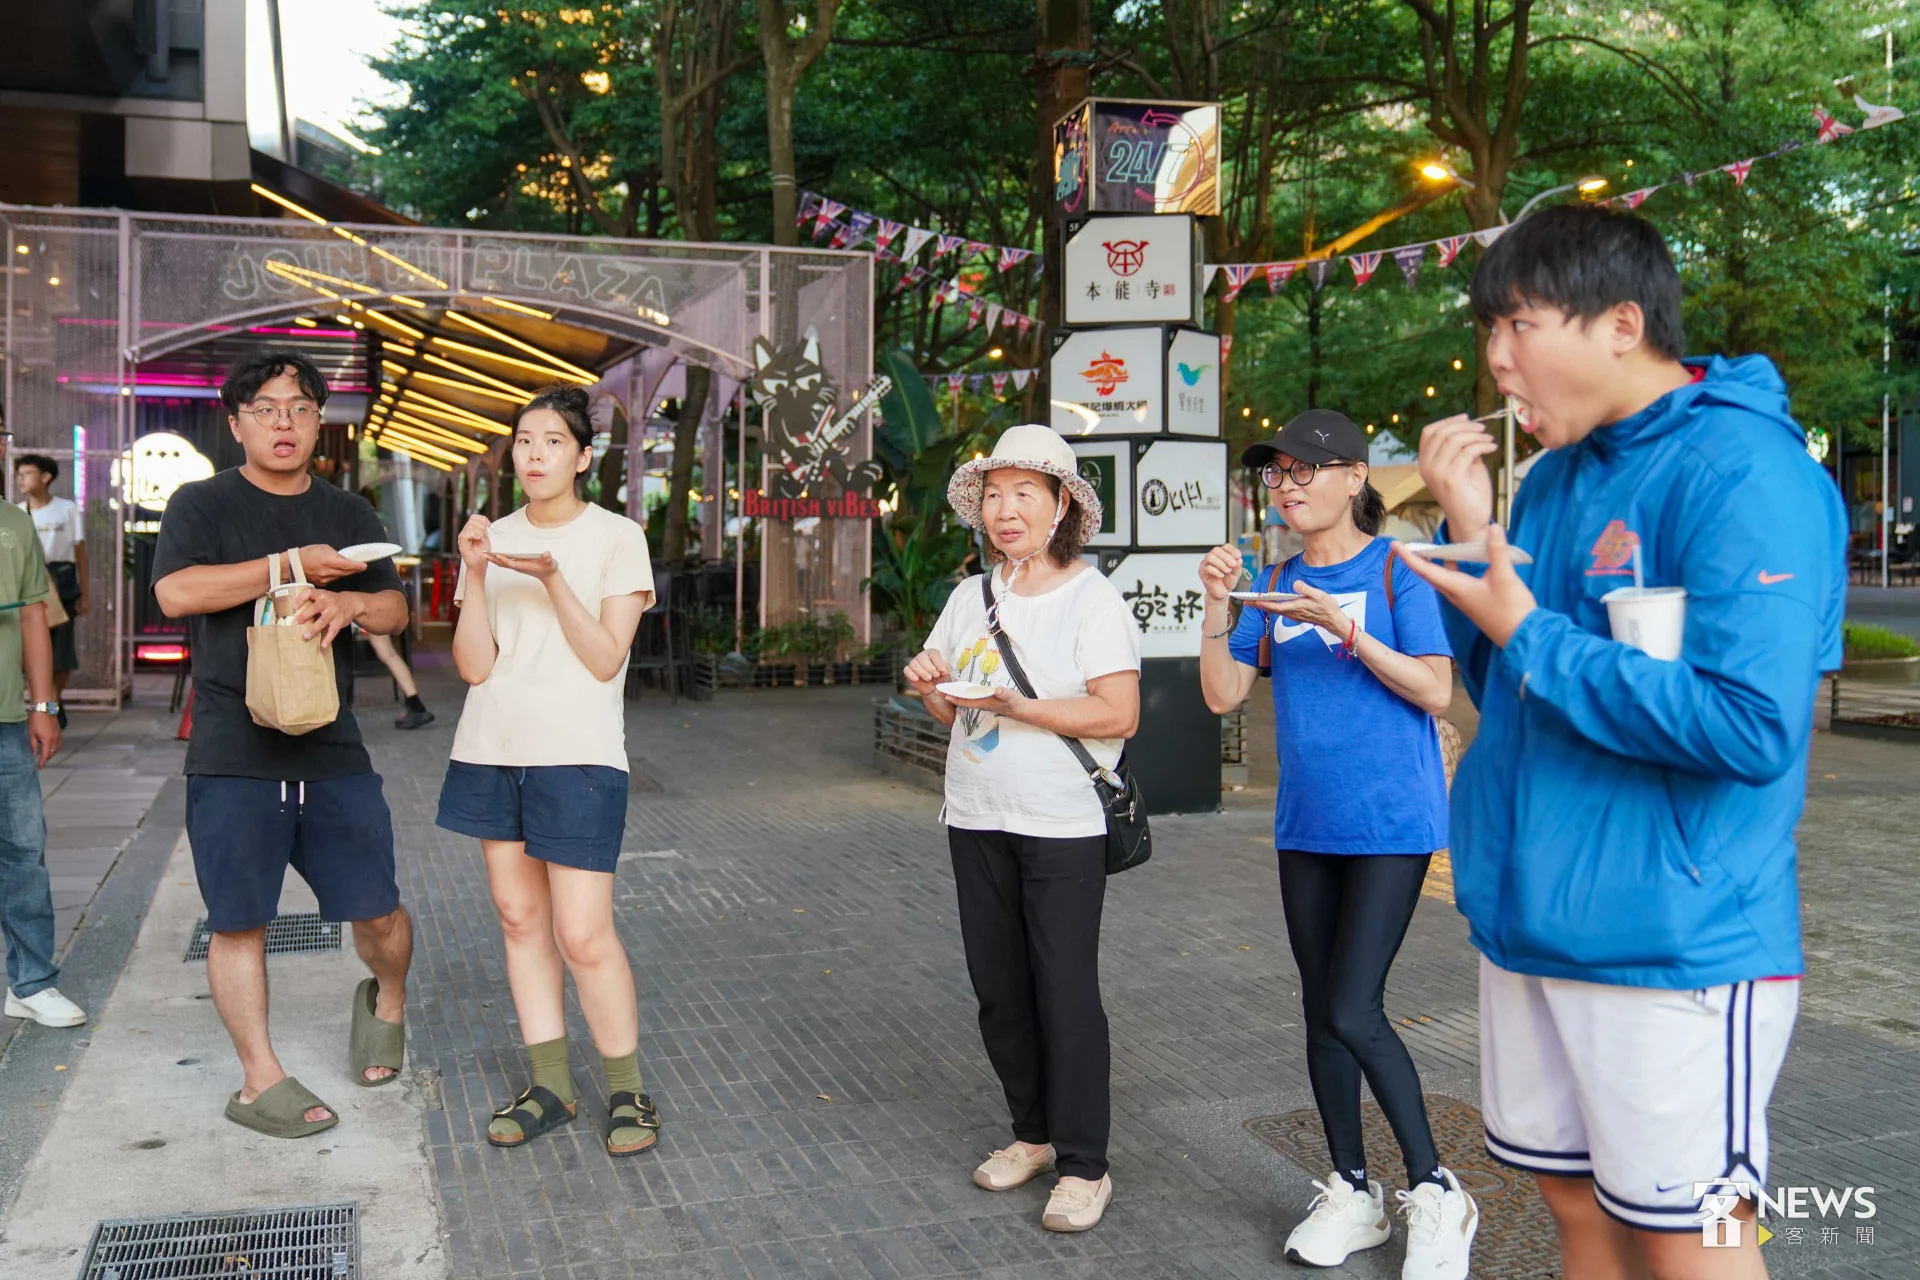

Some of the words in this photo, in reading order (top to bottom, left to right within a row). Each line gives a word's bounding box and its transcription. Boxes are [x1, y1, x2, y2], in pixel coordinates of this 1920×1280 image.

[1106, 140, 1190, 184] 24/7
[472, 243, 667, 316] PLAZA
[1085, 280, 1160, 300] 本能寺
[1053, 337, 1063, 346] 5F
[1122, 579, 1203, 633] 乾杯
